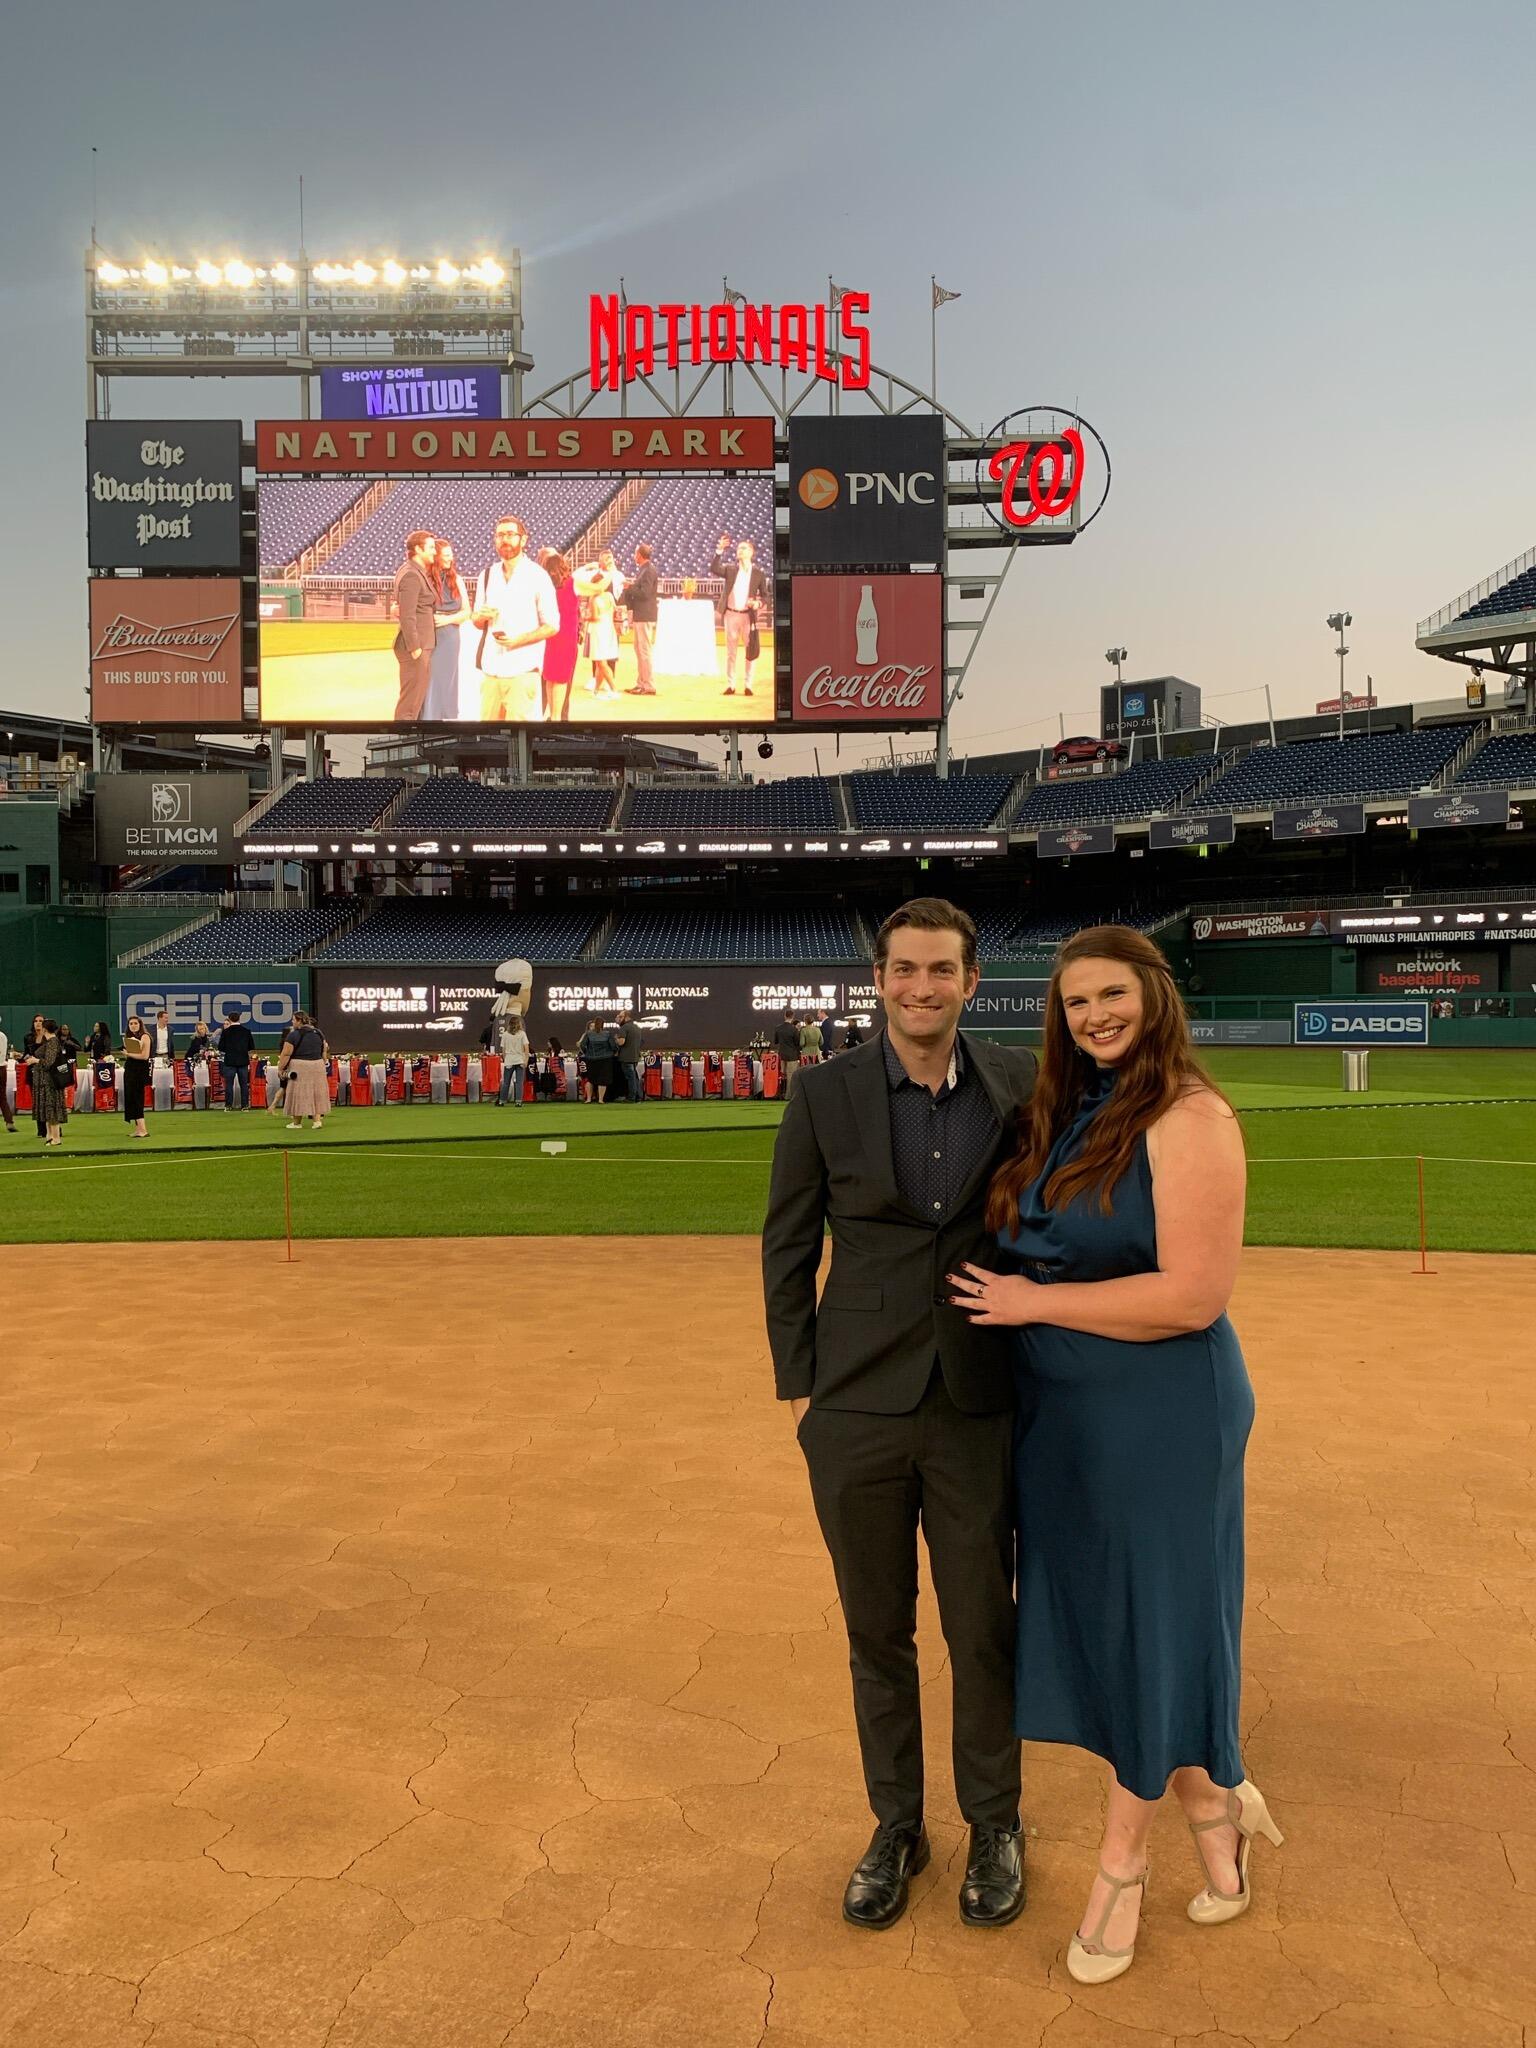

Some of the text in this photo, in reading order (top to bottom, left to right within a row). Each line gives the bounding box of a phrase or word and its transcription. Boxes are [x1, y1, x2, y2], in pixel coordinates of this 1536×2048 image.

[590, 292, 871, 391] NATIONALS
[342, 368, 424, 382] SHOW SOME
[365, 378, 478, 416] NATITUDE
[275, 429, 745, 458] NATIONALS PARK
[140, 440, 184, 469] The
[92, 471, 235, 508] Washington
[844, 472, 935, 505] PNC
[136, 513, 191, 547] Post
[104, 625, 224, 647] Budweiser
[103, 671, 229, 684] THIS BUD'S FOR YOU.
[801, 664, 935, 709] Coca-Cola
[1433, 807, 1480, 819] CHAMPIONS
[1171, 823, 1209, 837] CHAMPIONS
[1296, 819, 1339, 831] CHAMPIONS
[126, 827, 218, 844] BETMGM
[1056, 834, 1093, 843] CHAMPIONS
[169, 848, 218, 856] SPORTSBOOKS
[1216, 916, 1283, 931] WASHINGTON
[1247, 922, 1306, 936] NATIONALS
[1346, 933, 1395, 944] NATIONALS
[1397, 931, 1475, 943] PHILANTHROPIES
[1397, 958, 1461, 972] network
[1379, 973, 1481, 986] baseball fans
[341, 987, 402, 999] STADIUM
[440, 988, 499, 998] NATIONAL
[548, 987, 608, 998] STADIUM
[645, 987, 709, 997] NATIONALS
[752, 985, 812, 997] STADIUM
[126, 993, 293, 1024] GEICO
[341, 1000, 428, 1012] CHEF SERIES
[440, 1001, 469, 1011] PARK
[548, 999, 633, 1011] CHEF SERIES
[645, 1000, 674, 1010] PARK
[752, 998, 837, 1010] CHEF SERIES
[849, 999, 877, 1009] PARK
[965, 997, 1046, 1012] VENTURE
[1331, 1017, 1423, 1033] DABOS
[1191, 1027, 1215, 1037] RTX
